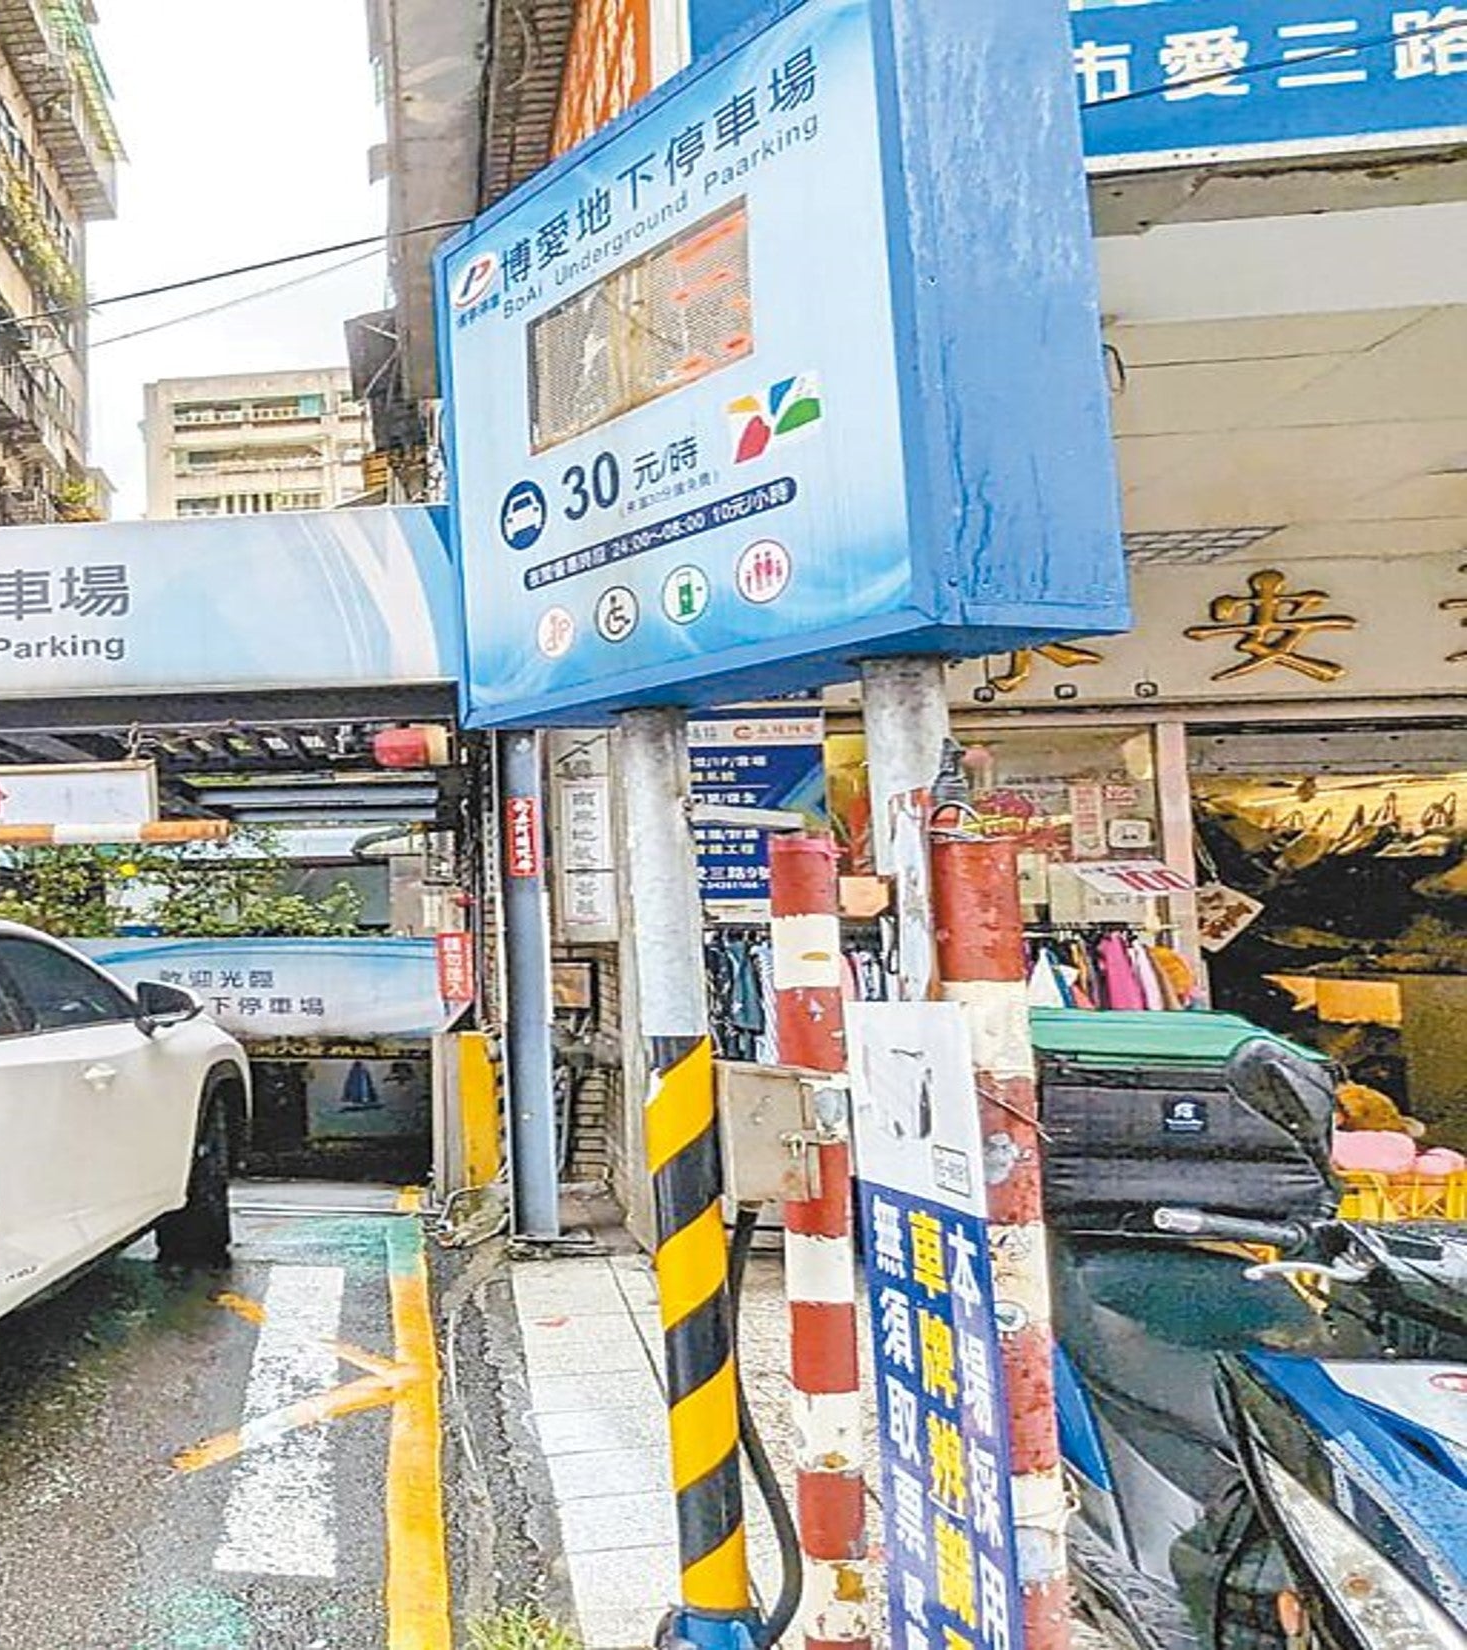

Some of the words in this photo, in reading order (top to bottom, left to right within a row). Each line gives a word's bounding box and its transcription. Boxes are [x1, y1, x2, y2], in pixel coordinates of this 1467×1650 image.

[501, 46, 817, 292] 博愛地下停車場
[554, 191, 688, 287] Underground
[704, 114, 818, 196] Paarking
[561, 450, 620, 520] 30
[633, 436, 698, 490] 元/時
[908, 1210, 977, 1649] 車牌辨識
